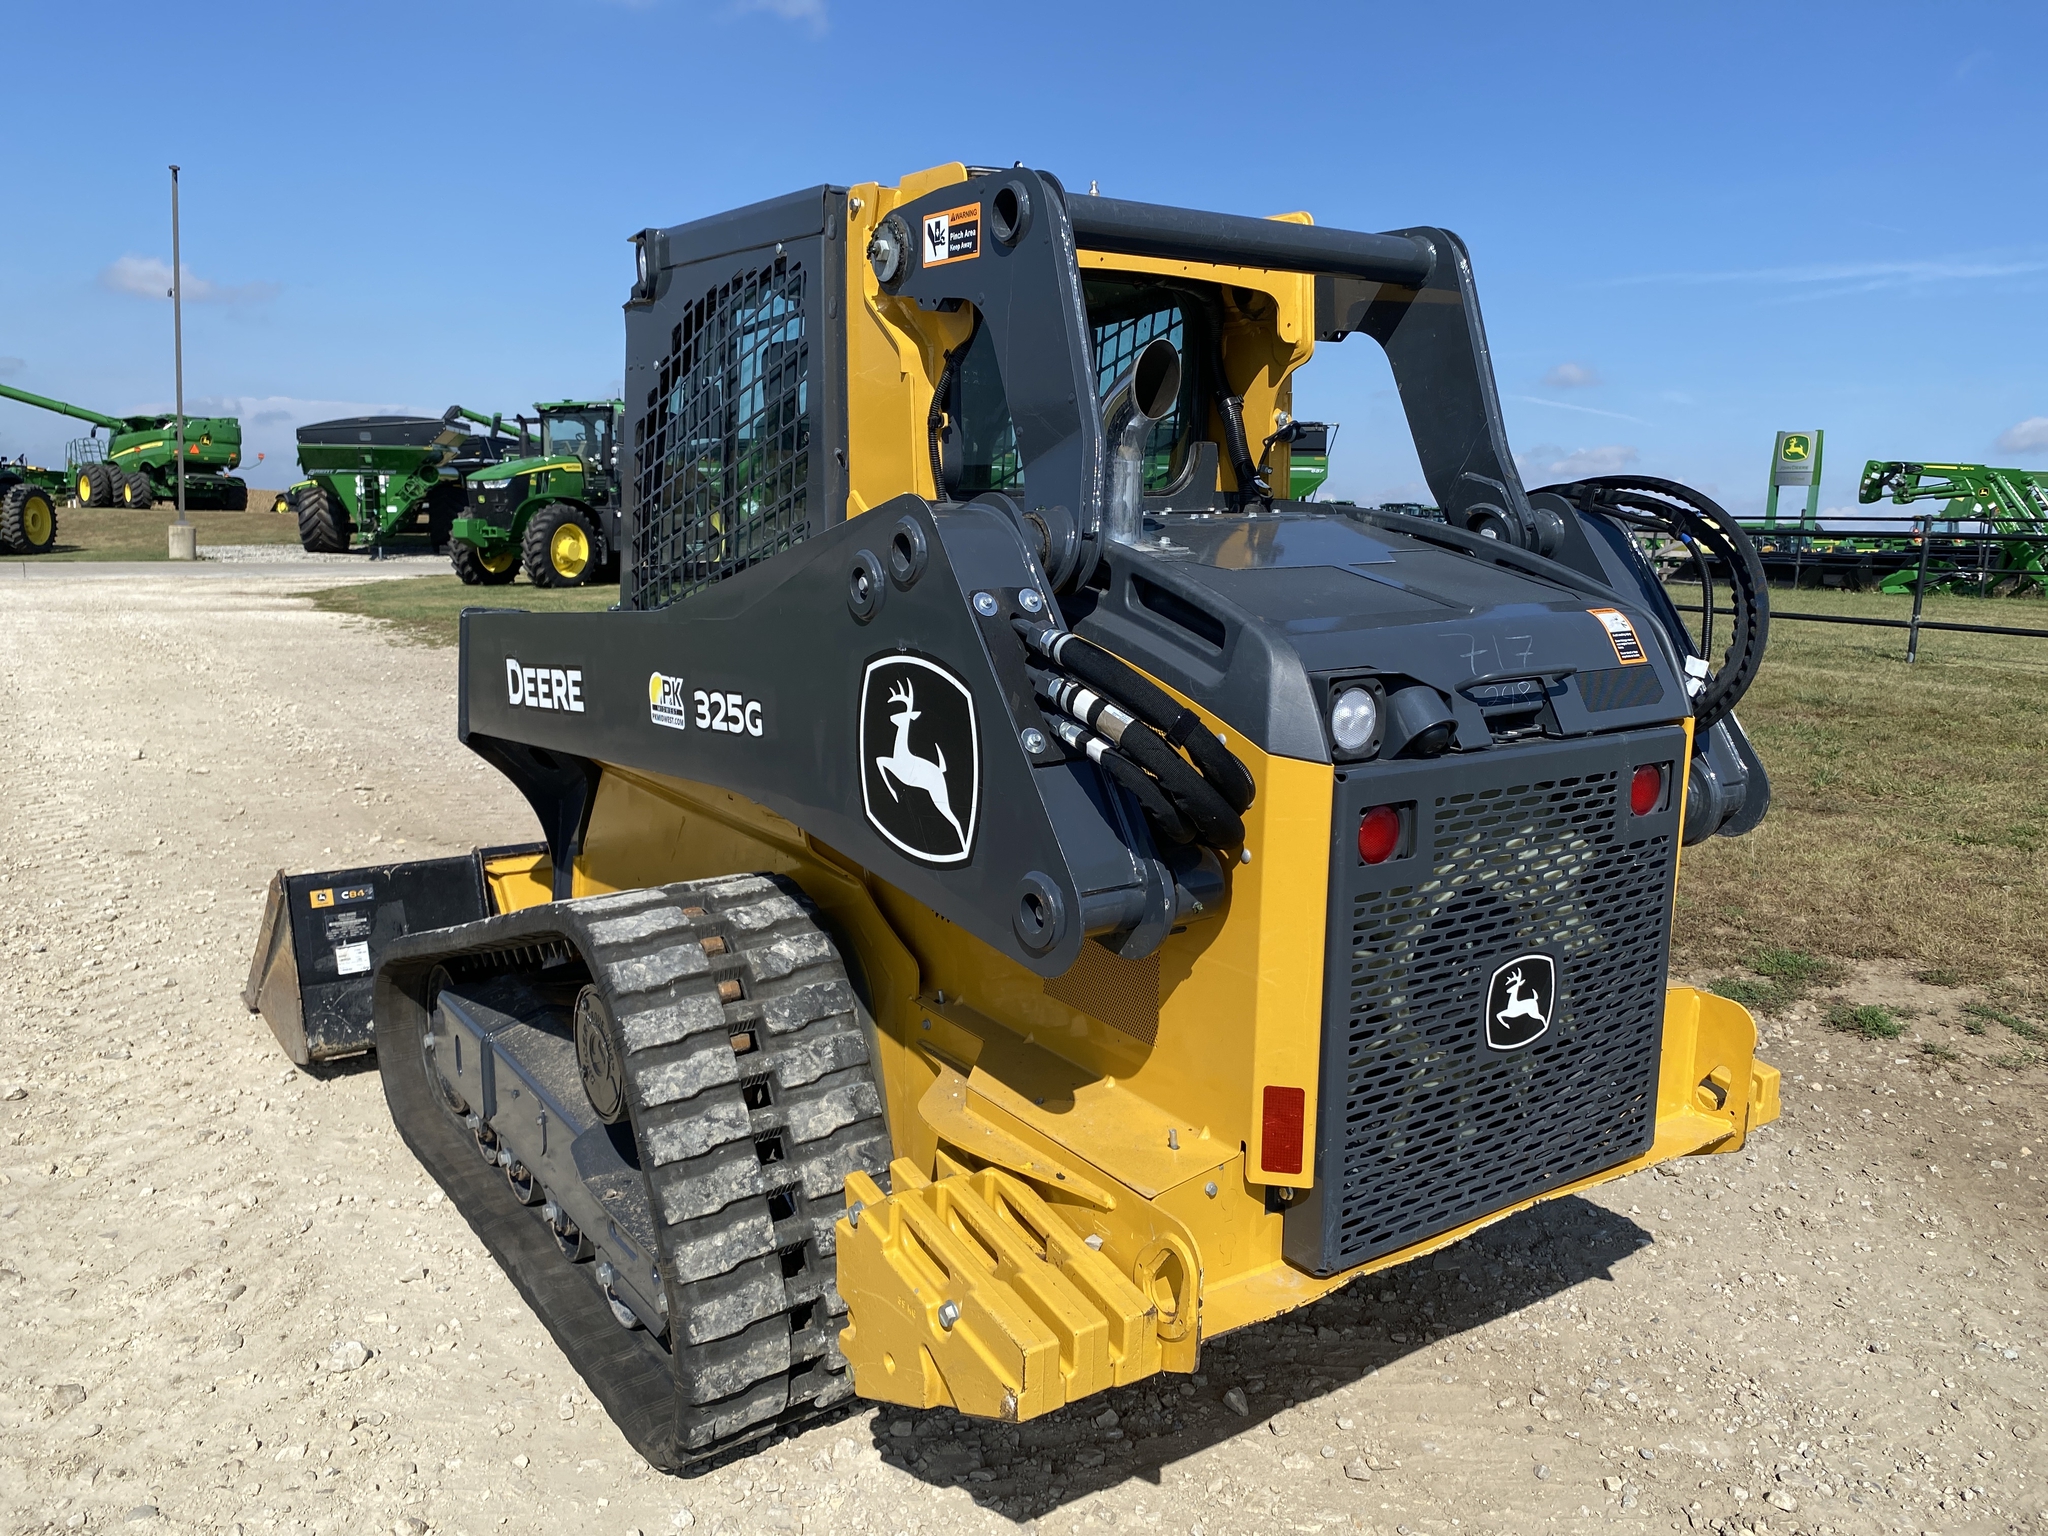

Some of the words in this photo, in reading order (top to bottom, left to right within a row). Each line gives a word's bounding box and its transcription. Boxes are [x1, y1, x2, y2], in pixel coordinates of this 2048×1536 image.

[955, 209, 977, 220] WARNING
[950, 231, 963, 241] Pinch
[964, 229, 976, 238] Area
[950, 244, 960, 252] Keep
[961, 241, 973, 250] Away
[1438, 633, 1534, 676] 717
[506, 658, 585, 713] DEERE
[1484, 681, 1531, 709] 248
[652, 713, 684, 726] PKMIDWEST.COM
[693, 690, 763, 737] 325G
[341, 888, 365, 900] C84
